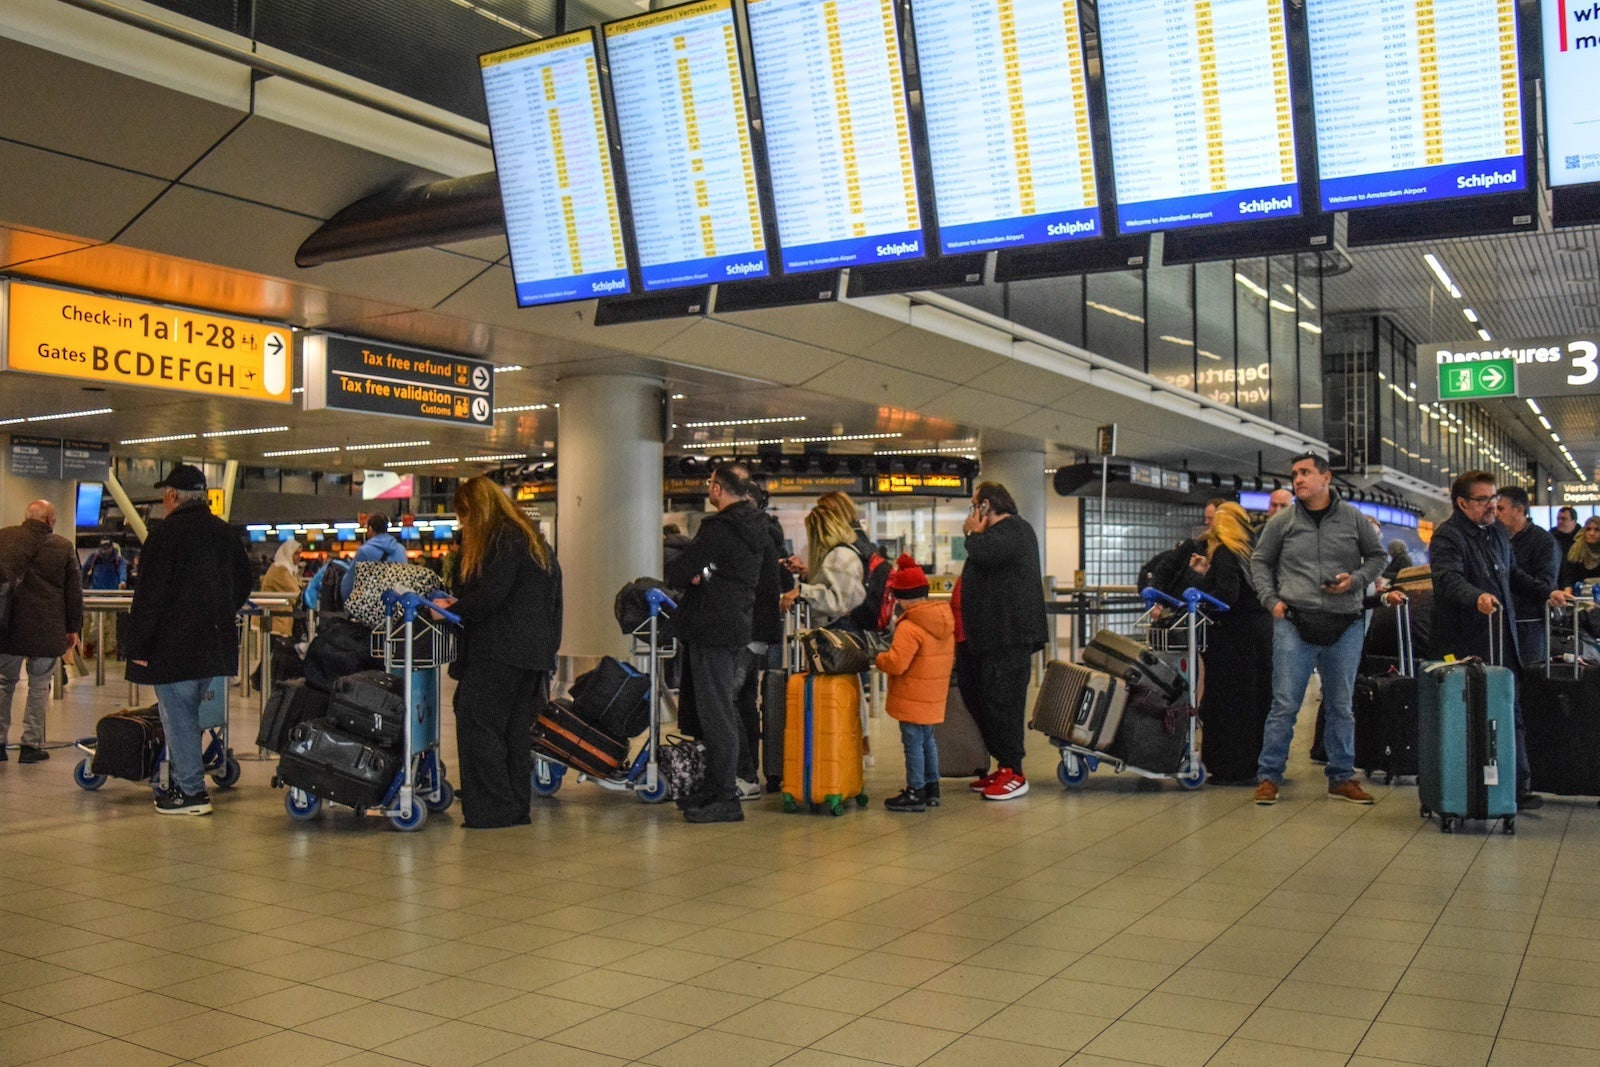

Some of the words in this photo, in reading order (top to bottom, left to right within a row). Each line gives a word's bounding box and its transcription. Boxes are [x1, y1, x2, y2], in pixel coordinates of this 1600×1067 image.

[616, 22, 635, 32] Flight
[636, 14, 674, 28] departures
[679, 3, 718, 18] Vertrekken
[546, 36, 580, 50] Vertrekken
[1456, 170, 1517, 189] Schiphol
[1328, 195, 1357, 204] Welcome
[1366, 188, 1402, 200] Amsterdam
[1403, 186, 1428, 196] Airport
[1238, 196, 1292, 214] Schiphol
[1046, 218, 1095, 236] Schiphol
[1125, 218, 1151, 228] Welcome
[1159, 212, 1192, 223] Amsterdam
[1192, 210, 1213, 220] Airport
[876, 240, 918, 257] Schiphol
[946, 241, 970, 249] Welcome
[976, 236, 1006, 246] Amsterdam
[1006, 234, 1024, 242] Airport
[726, 260, 764, 276] Schiphol
[814, 256, 840, 265] Amsterdam
[840, 254, 856, 262] Airport
[592, 278, 626, 292] Schiphol
[62, 305, 132, 328] Check-in
[138, 313, 168, 340] 1a
[183, 320, 236, 350] 1-28
[38, 343, 86, 363] Gates
[362, 350, 384, 366] Tax
[386, 354, 411, 371] free
[414, 360, 452, 377] refund
[1566, 340, 1599, 386] 3
[340, 376, 362, 394] Tax
[365, 380, 390, 396] free
[393, 384, 452, 404] validation
[420, 404, 452, 416] Customs
[891, 476, 904, 486] Tax
[906, 476, 922, 486] free
[922, 476, 961, 486] validation
